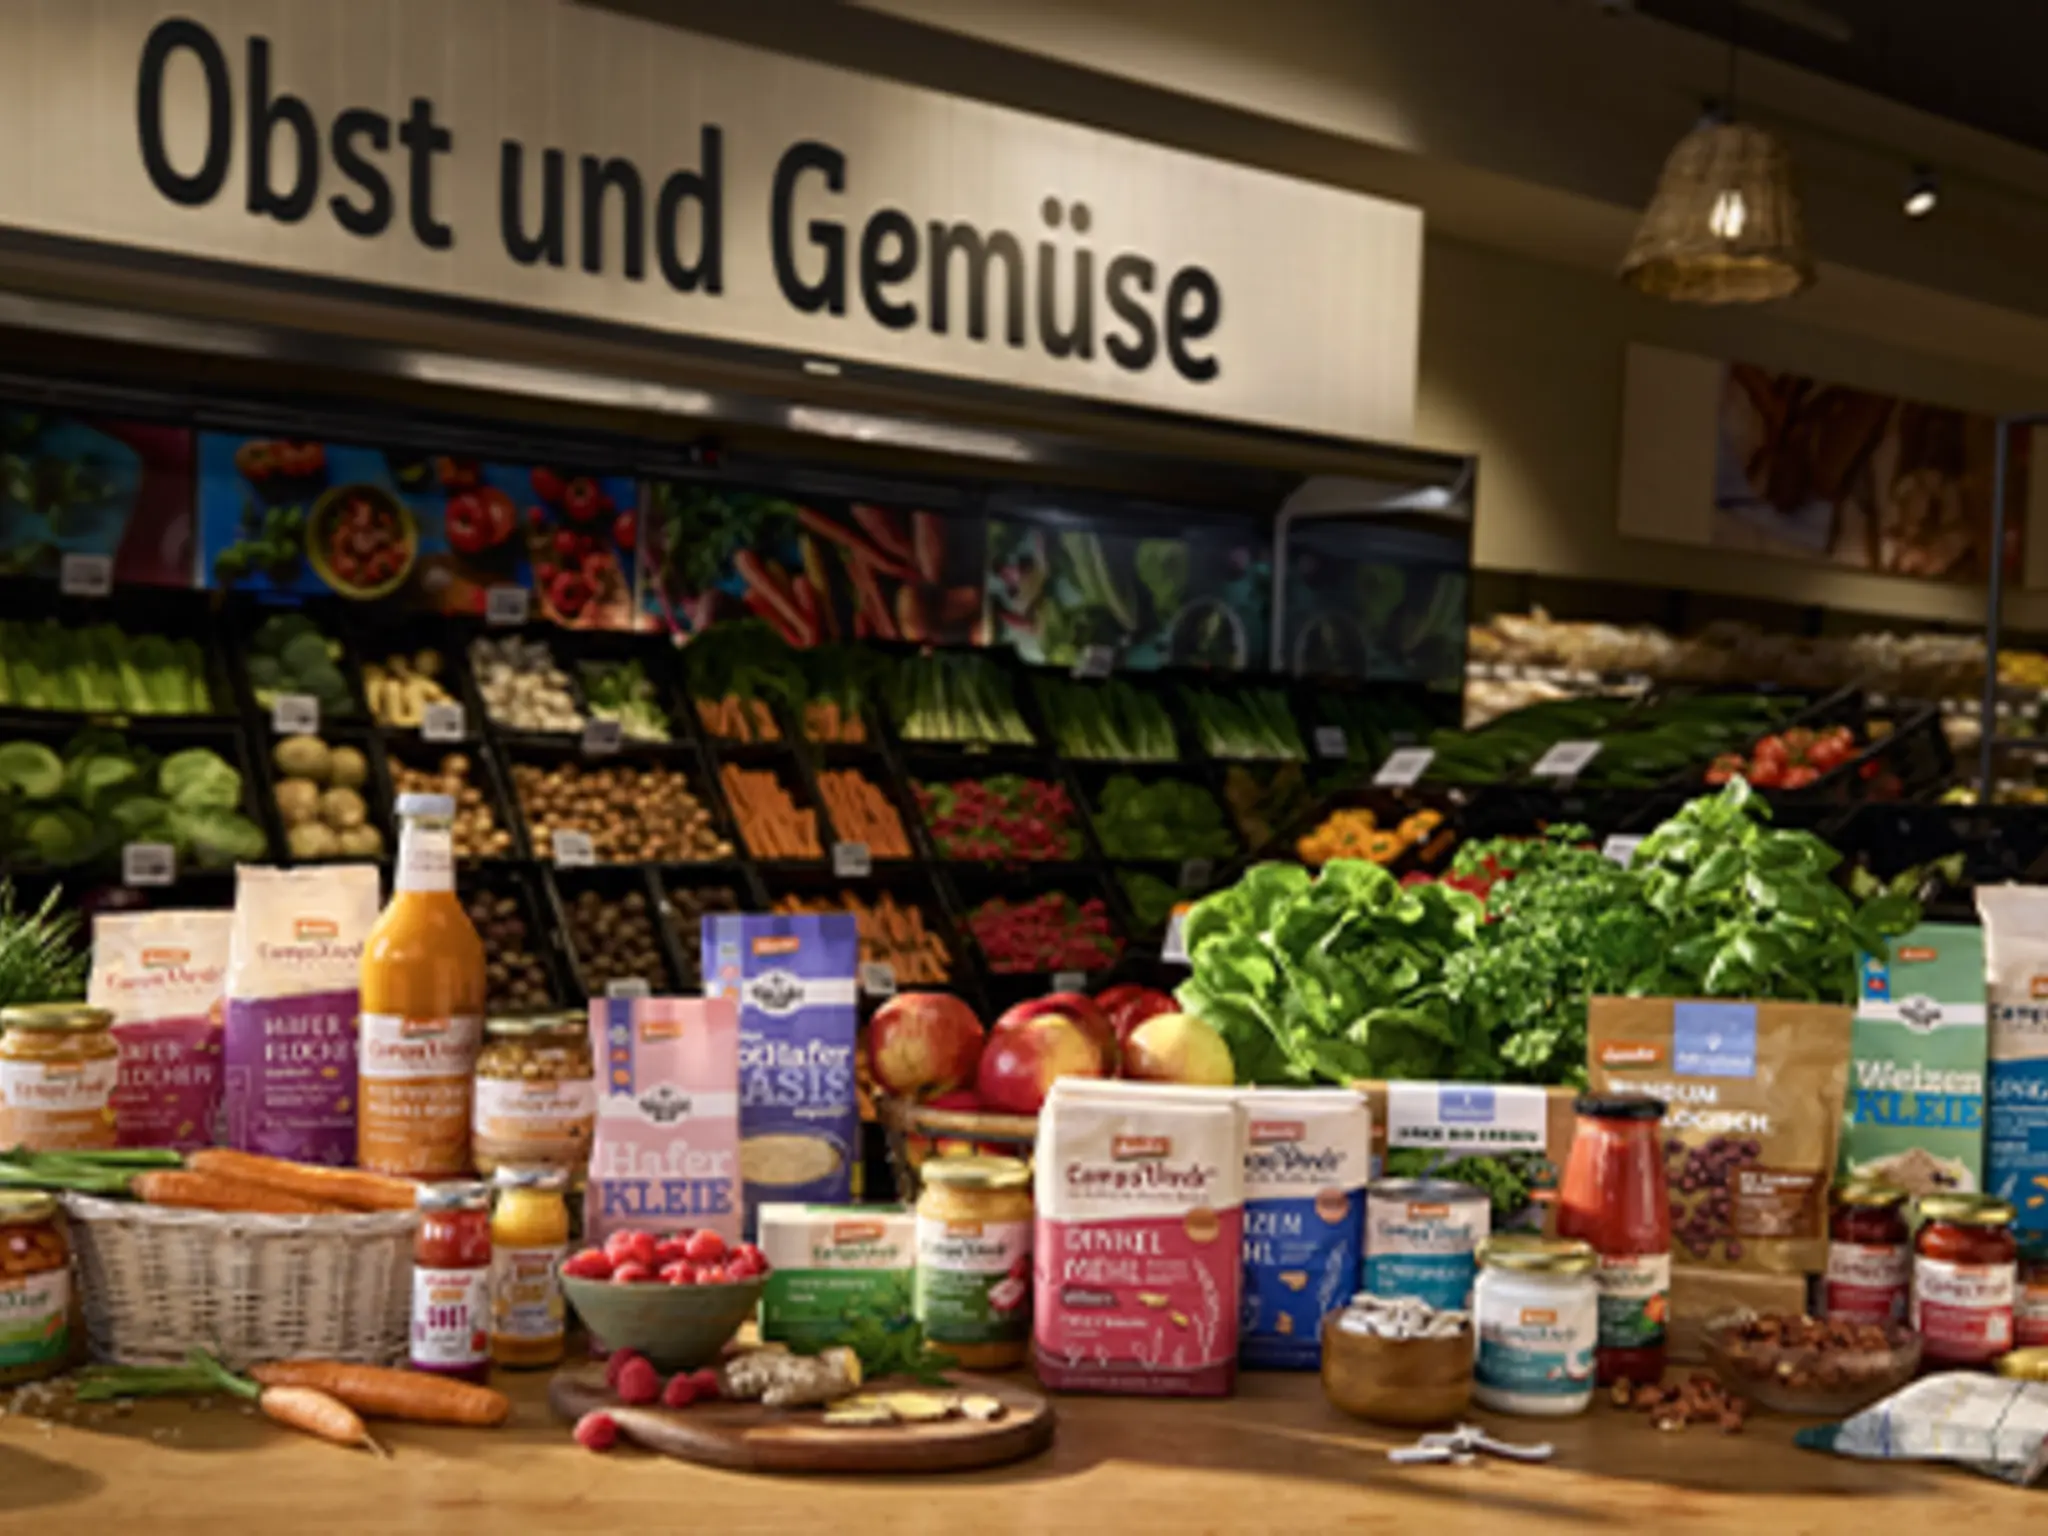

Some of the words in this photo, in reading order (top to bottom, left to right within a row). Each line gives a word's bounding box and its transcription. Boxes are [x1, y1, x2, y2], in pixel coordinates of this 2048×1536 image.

[136, 17, 455, 251] Obst
[499, 123, 724, 295] und
[770, 141, 1223, 383] Gemüse
[740, 1067, 850, 1106] ASIS
[1855, 1060, 1982, 1093] Weizen
[1855, 1090, 1983, 1128] KLEIE
[604, 1141, 734, 1180] Hafer
[603, 1179, 733, 1218] KLEIE
